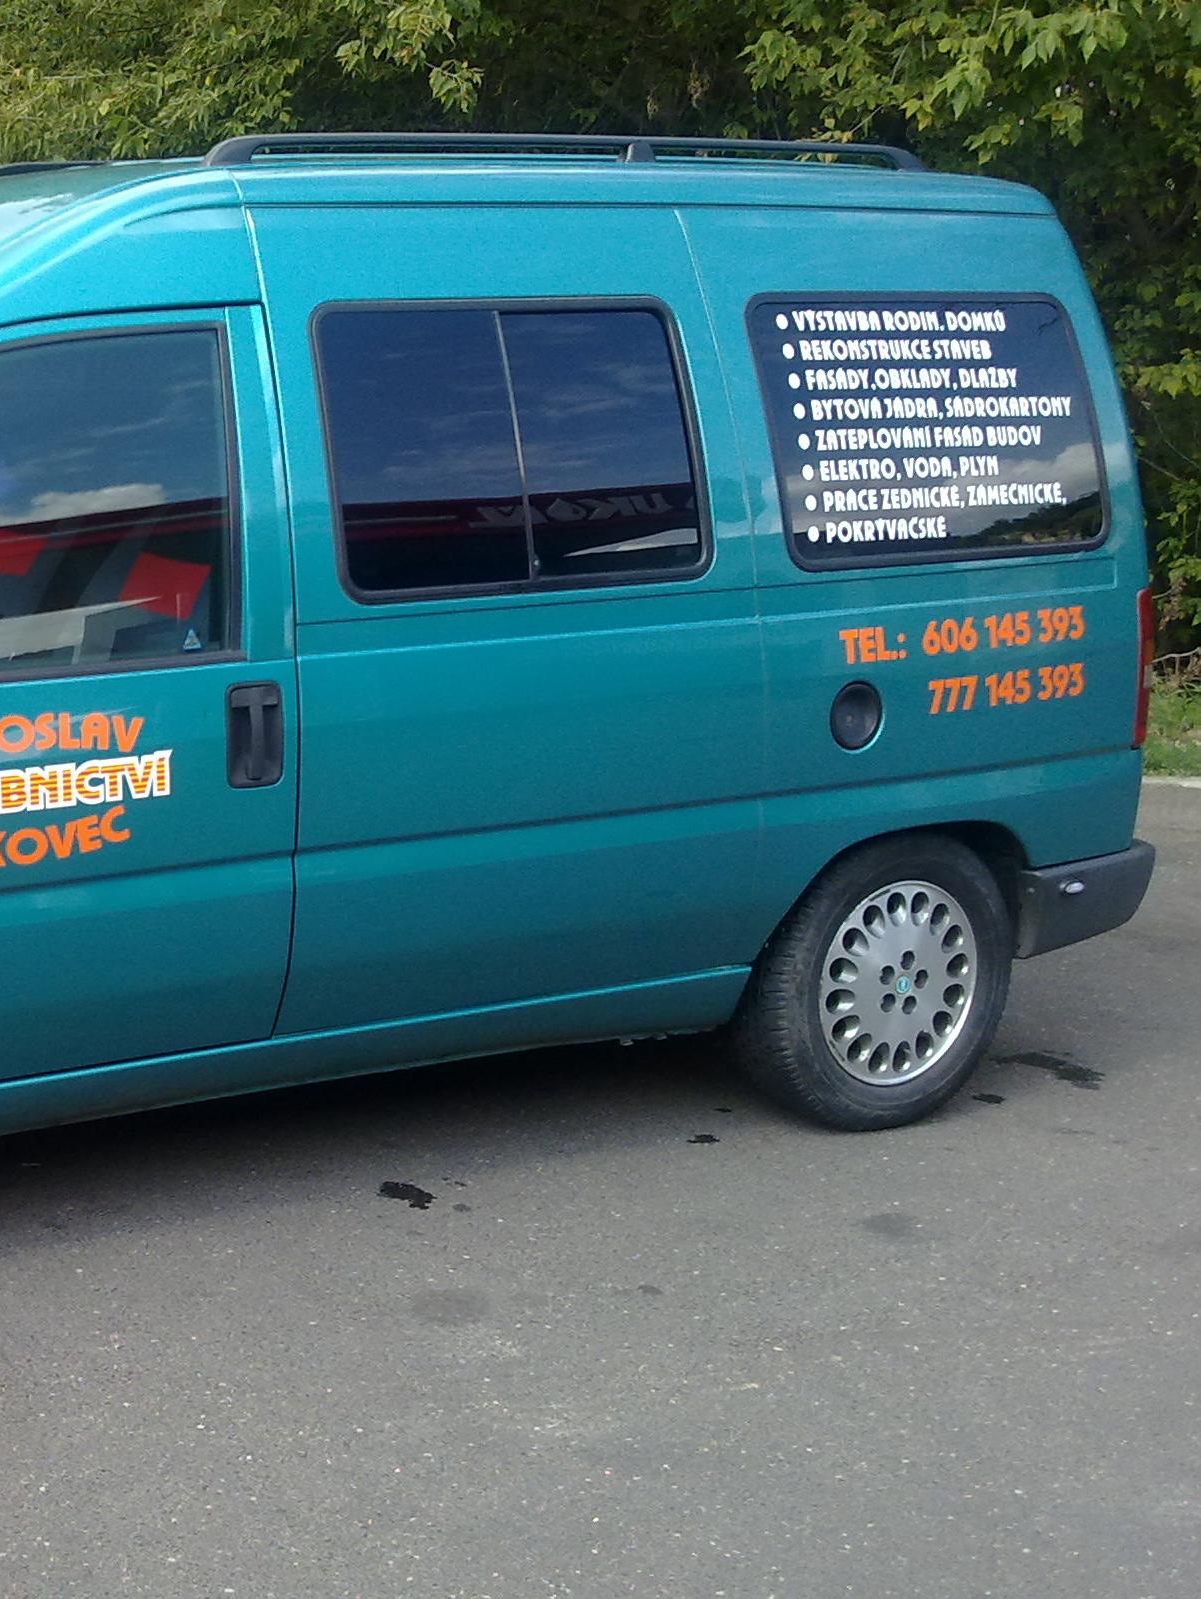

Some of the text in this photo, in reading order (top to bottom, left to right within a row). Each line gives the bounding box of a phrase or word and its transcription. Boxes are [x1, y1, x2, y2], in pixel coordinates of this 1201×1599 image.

[881, 310, 945, 332] RODIN.
[798, 338, 992, 361] REKONSTRUKCE STAVEB
[985, 425, 1041, 447] BUDOV
[819, 455, 1000, 482] ELEKTRO, VODA, PLYN
[840, 606, 1084, 663] TEL.: 606 145 393
[929, 663, 1083, 713] 777 145 393
